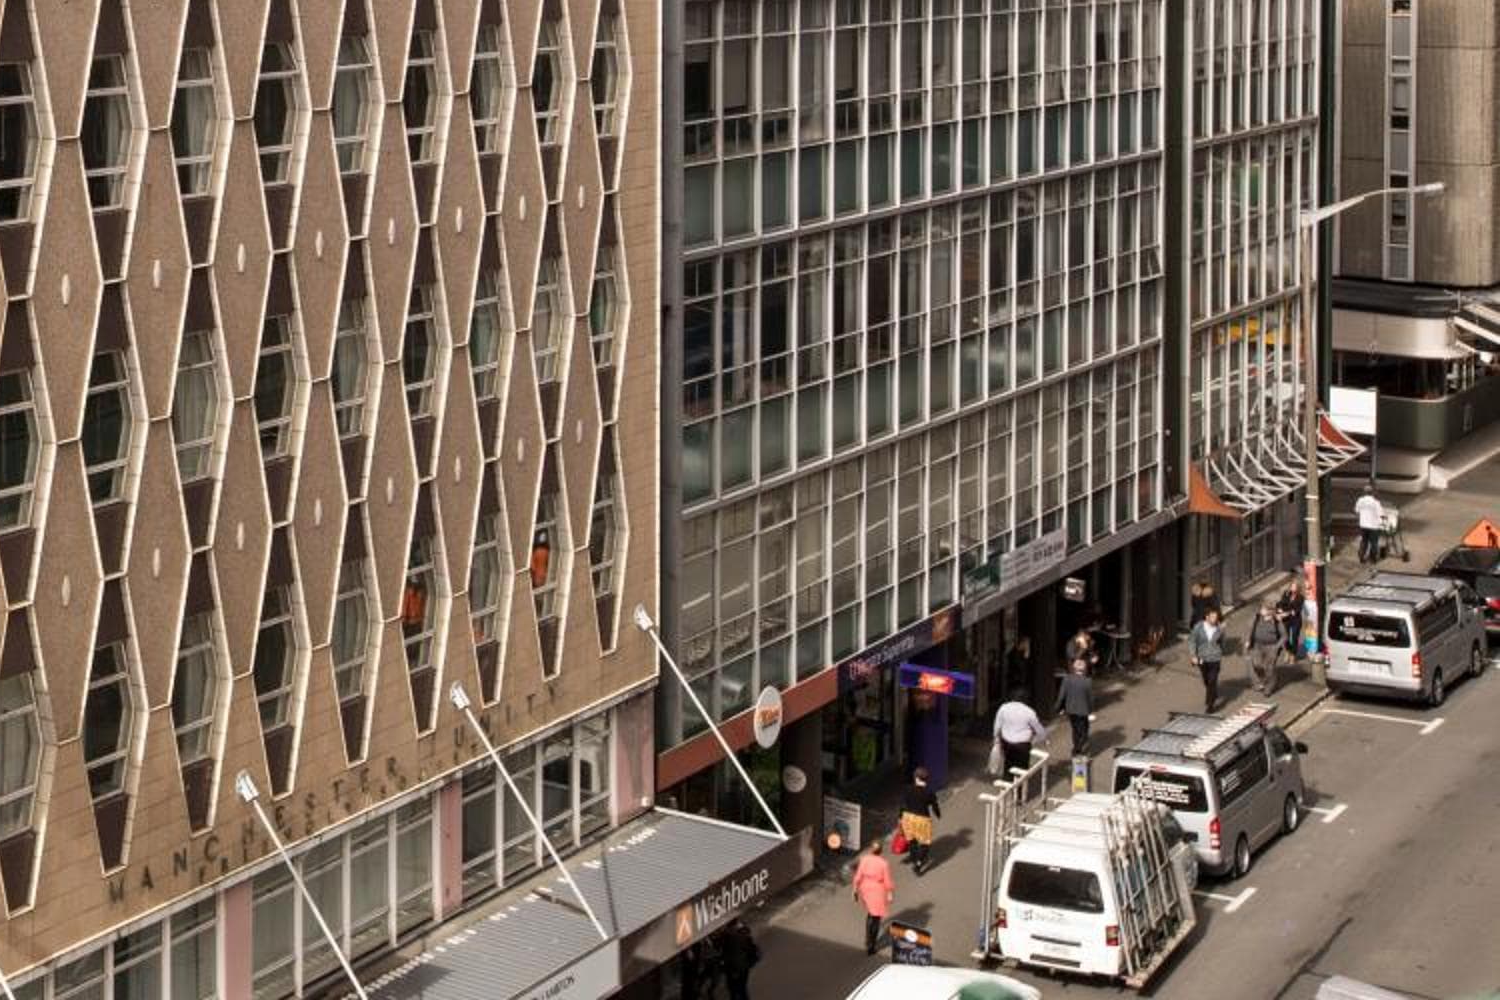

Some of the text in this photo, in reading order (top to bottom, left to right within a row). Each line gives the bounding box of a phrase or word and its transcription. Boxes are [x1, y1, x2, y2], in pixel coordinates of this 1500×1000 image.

[109, 756, 398, 903] MANCHESTER
[453, 683, 556, 749] UNITY
[695, 868, 770, 931] Wishbone
